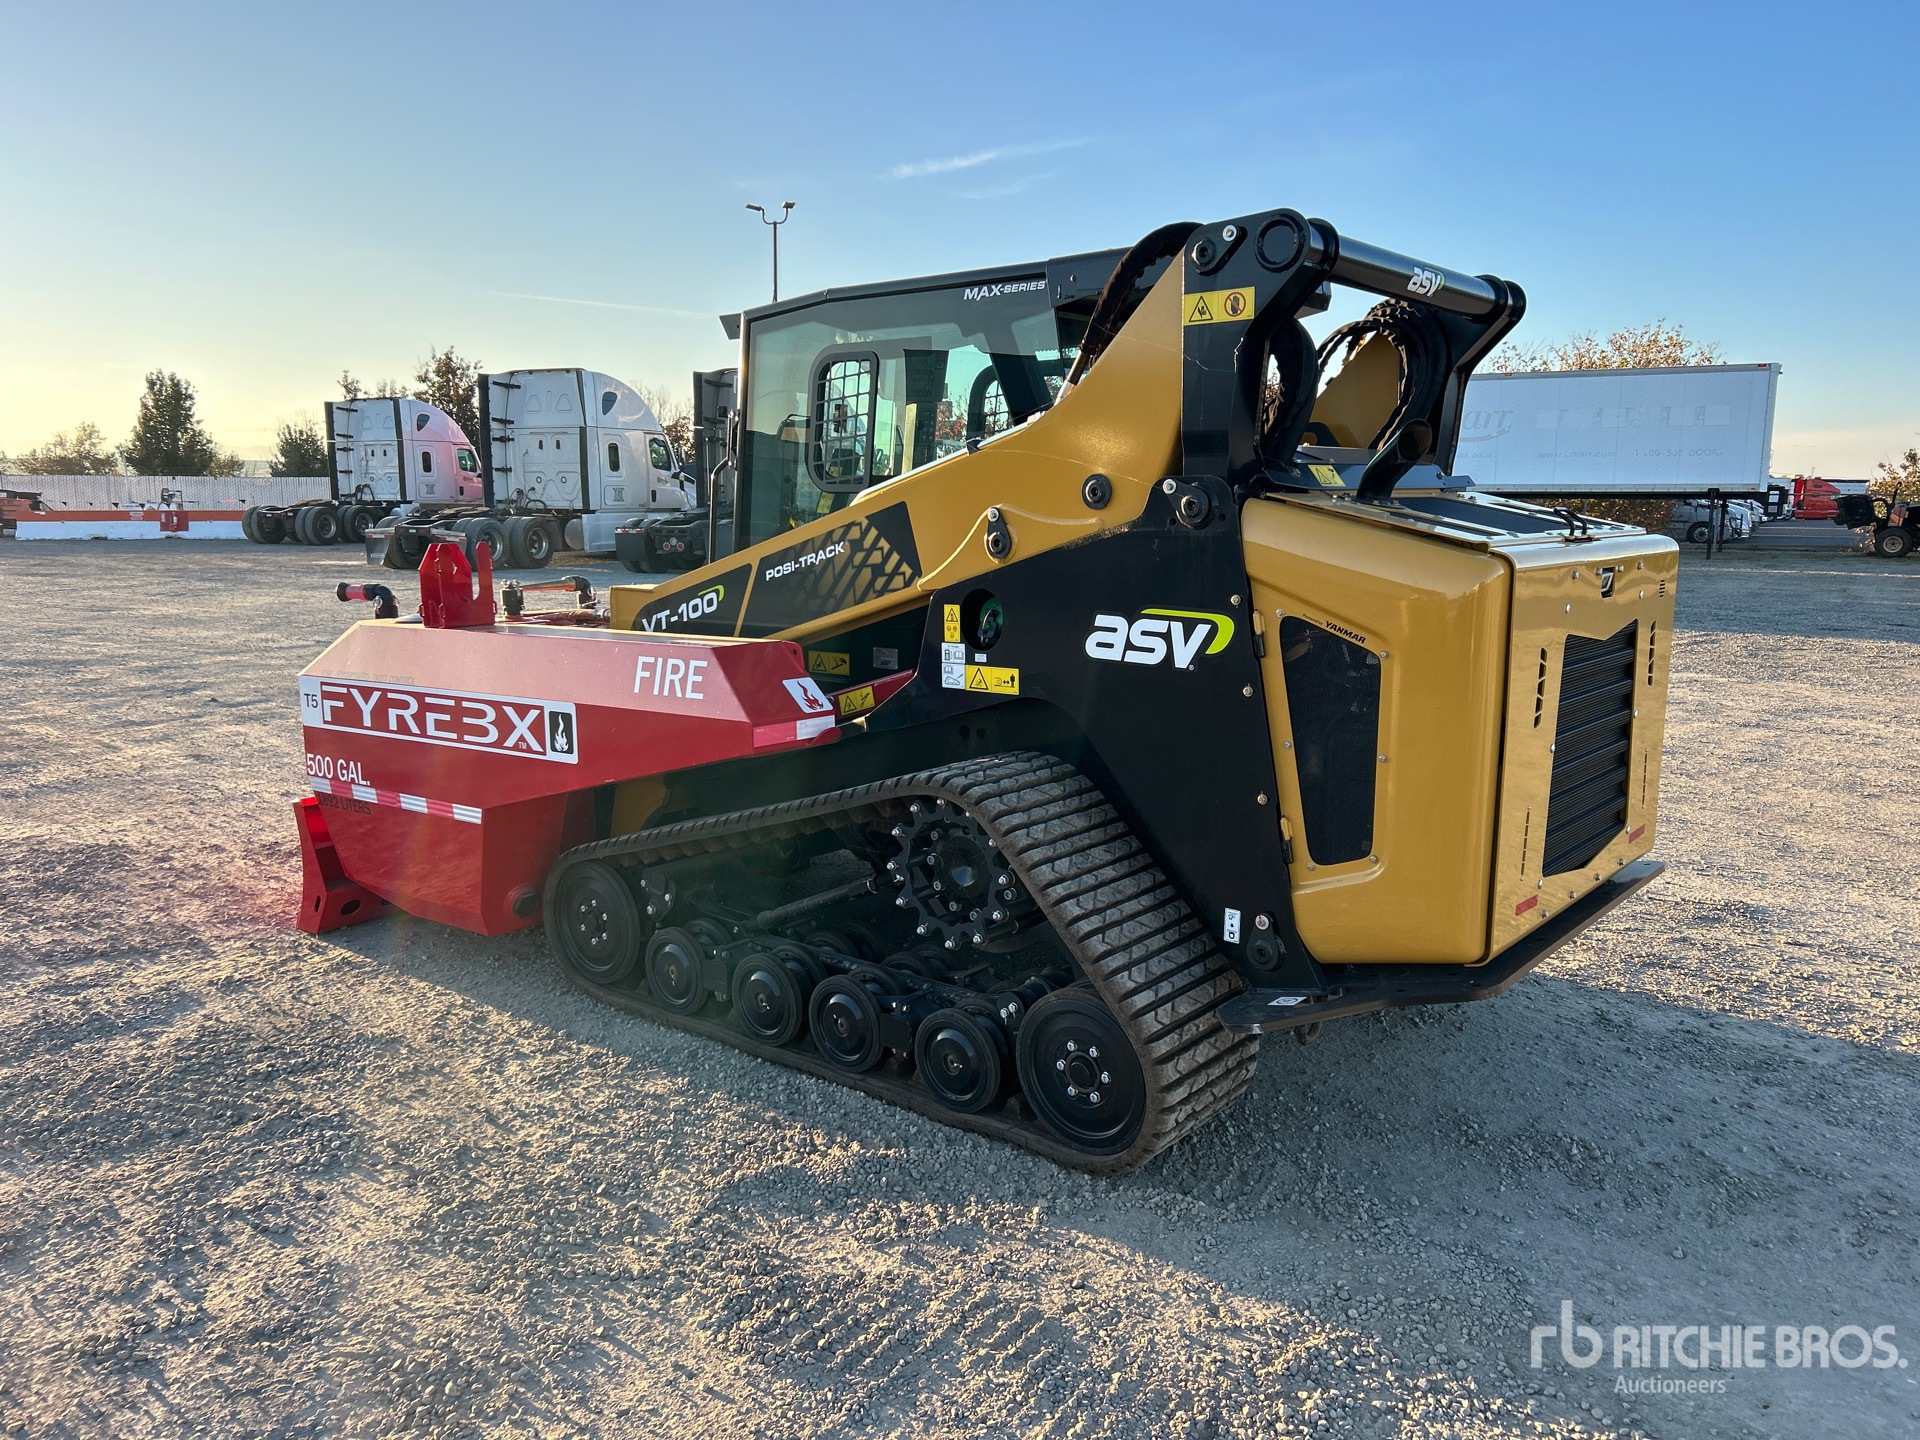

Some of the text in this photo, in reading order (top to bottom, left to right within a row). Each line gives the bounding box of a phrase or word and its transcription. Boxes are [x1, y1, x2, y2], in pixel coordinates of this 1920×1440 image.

[963, 280, 1046, 301] MAX-SERIES
[765, 541, 846, 582] POSI-TRACK
[641, 591, 719, 631] VT-100
[1085, 614, 1212, 670] asv
[1325, 620, 1366, 644] YANMAR
[632, 655, 708, 701] FIRE
[304, 693, 319, 709] T5
[306, 753, 371, 786] 500 GAL.
[318, 793, 371, 815] 1892 LITERS
